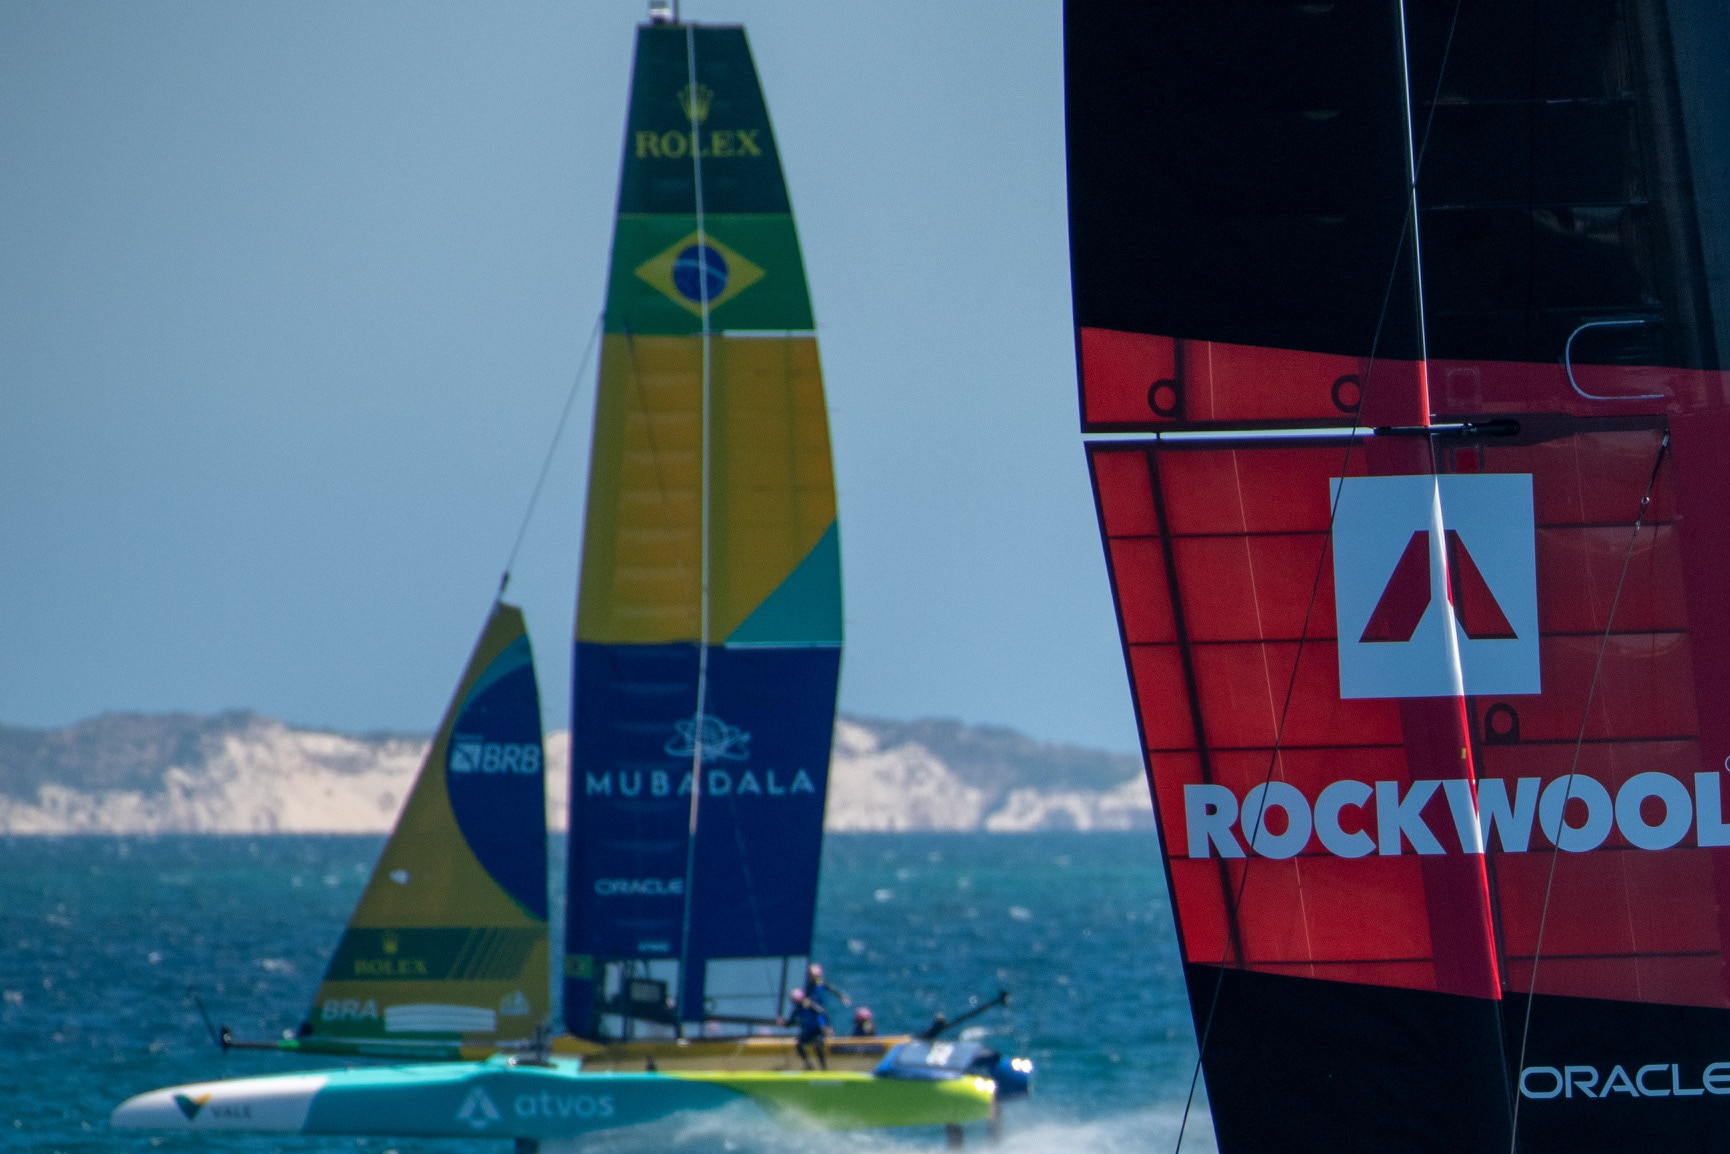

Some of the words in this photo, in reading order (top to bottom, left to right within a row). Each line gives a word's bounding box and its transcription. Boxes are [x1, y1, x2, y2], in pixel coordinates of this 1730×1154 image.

[636, 131, 761, 157] ROLEX
[483, 742, 540, 774] BRB
[585, 769, 815, 796] MUBADALA
[594, 877, 685, 896] ORACLE
[514, 1091, 615, 1118] atvos
